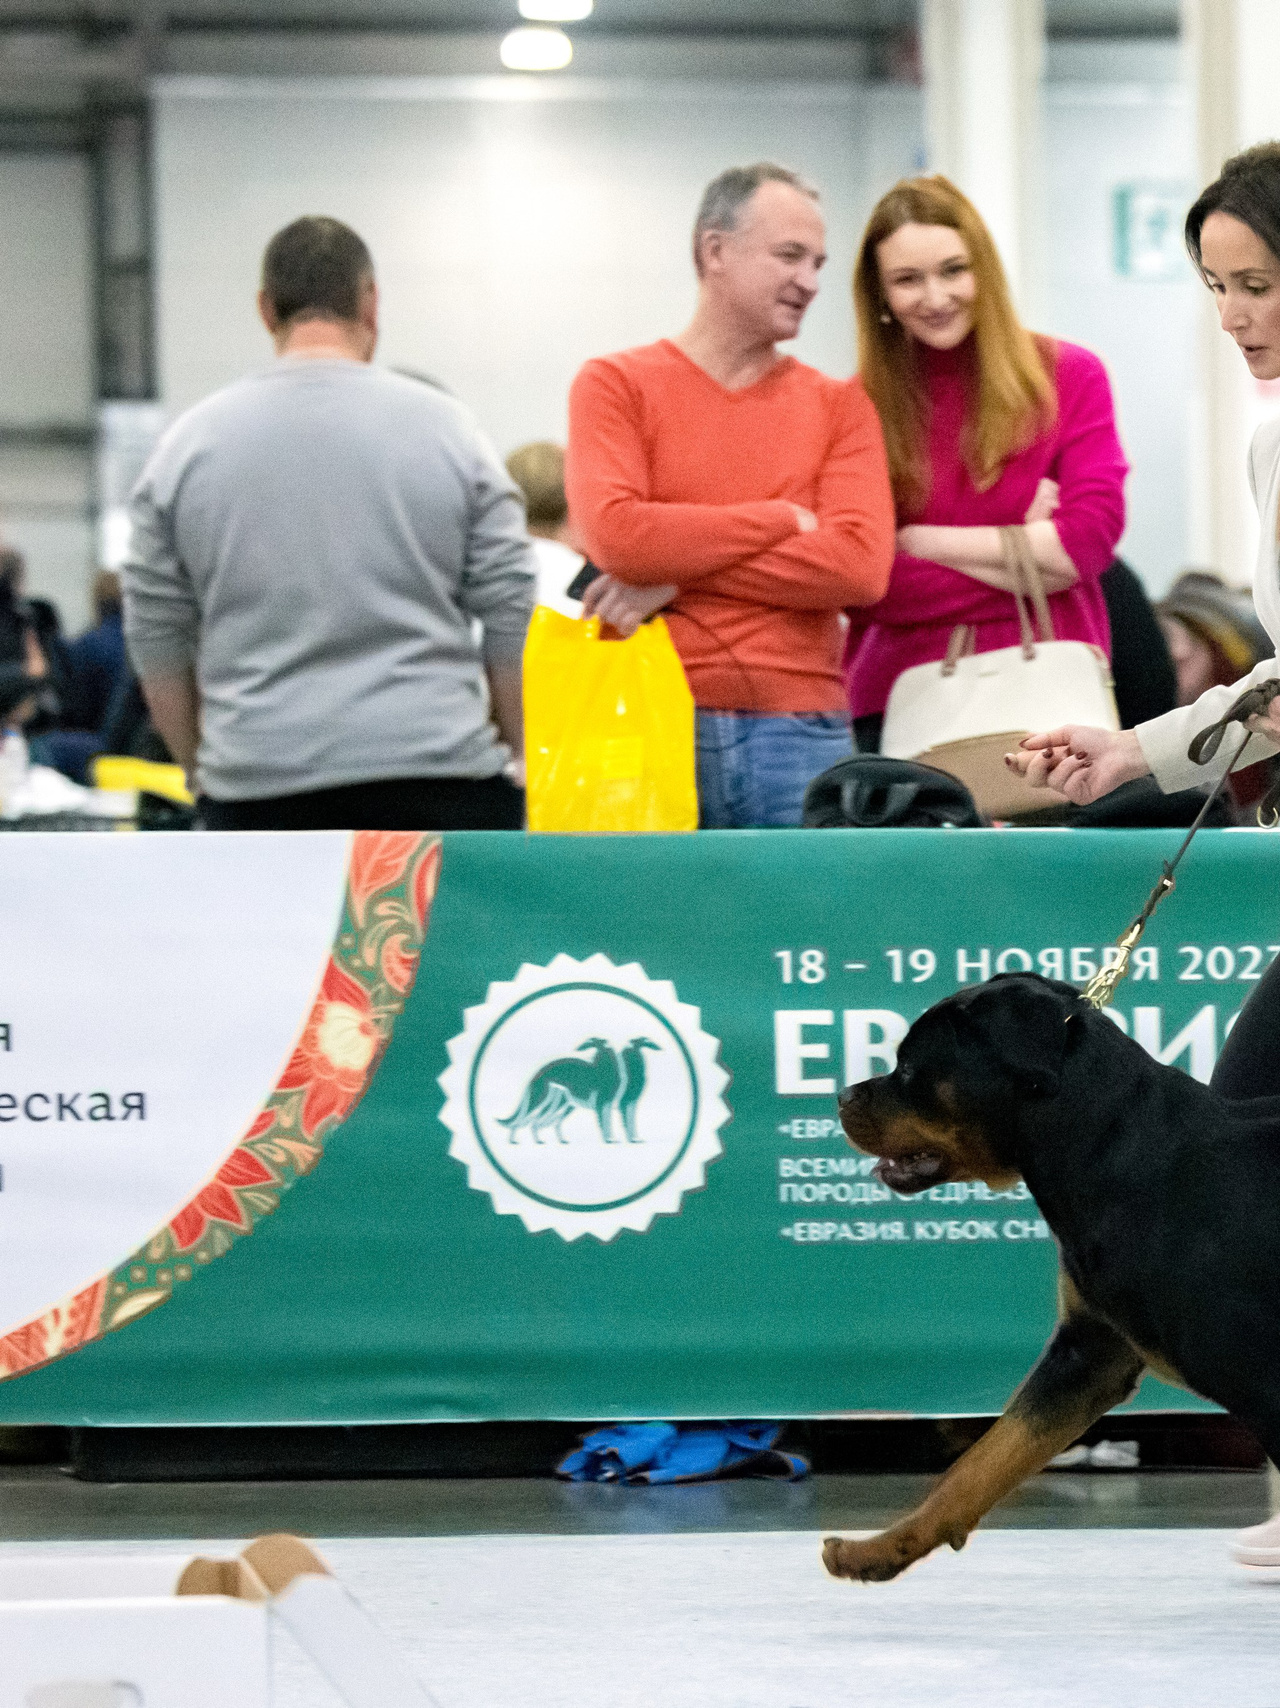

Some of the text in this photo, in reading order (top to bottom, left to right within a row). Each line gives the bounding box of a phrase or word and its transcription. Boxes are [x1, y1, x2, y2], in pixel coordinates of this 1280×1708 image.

[775, 949, 826, 984] 18
[885, 948, 937, 983] 19
[779, 1183, 891, 1205] ПОРОДЫ
[914, 1220, 998, 1240] КУБОК
